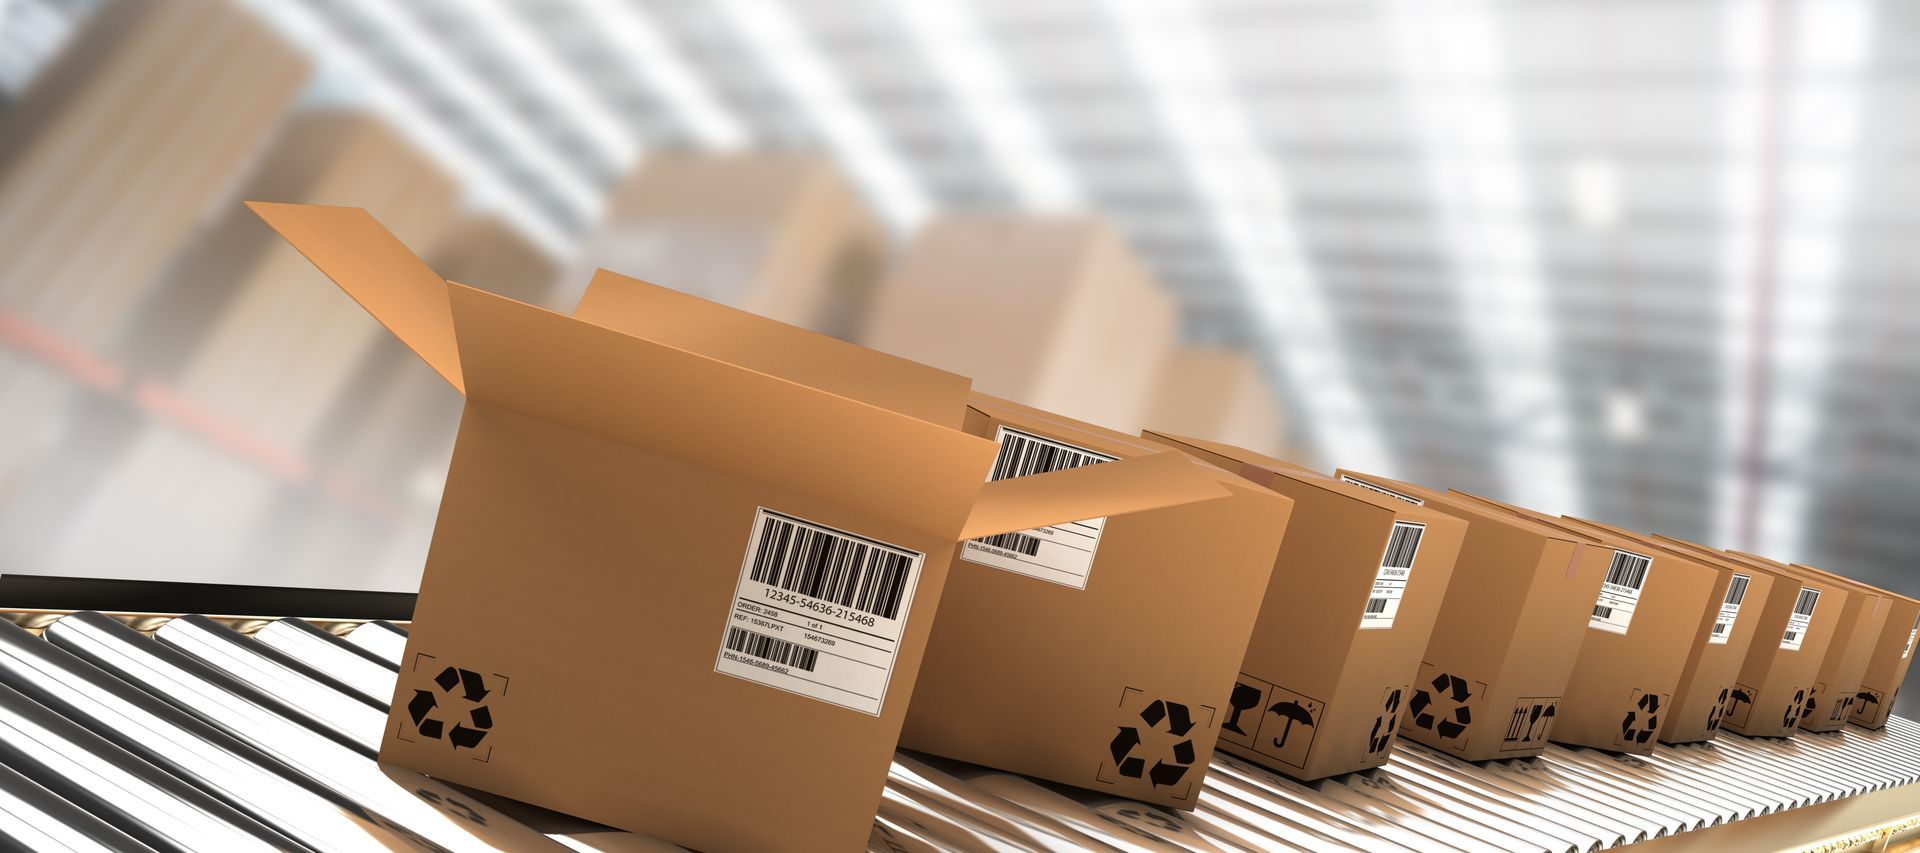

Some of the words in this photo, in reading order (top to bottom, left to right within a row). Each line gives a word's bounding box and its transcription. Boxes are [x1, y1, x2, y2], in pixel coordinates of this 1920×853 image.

[737, 601, 762, 613] ORDER:
[763, 608, 779, 618] 2458
[764, 588, 876, 628] 12345-54636-215468
[734, 613, 749, 622] REF:
[750, 618, 785, 632] 15367LPXT
[804, 632, 836, 647] 154673269
[723, 651, 790, 674] PHN-1546-5689-45662
